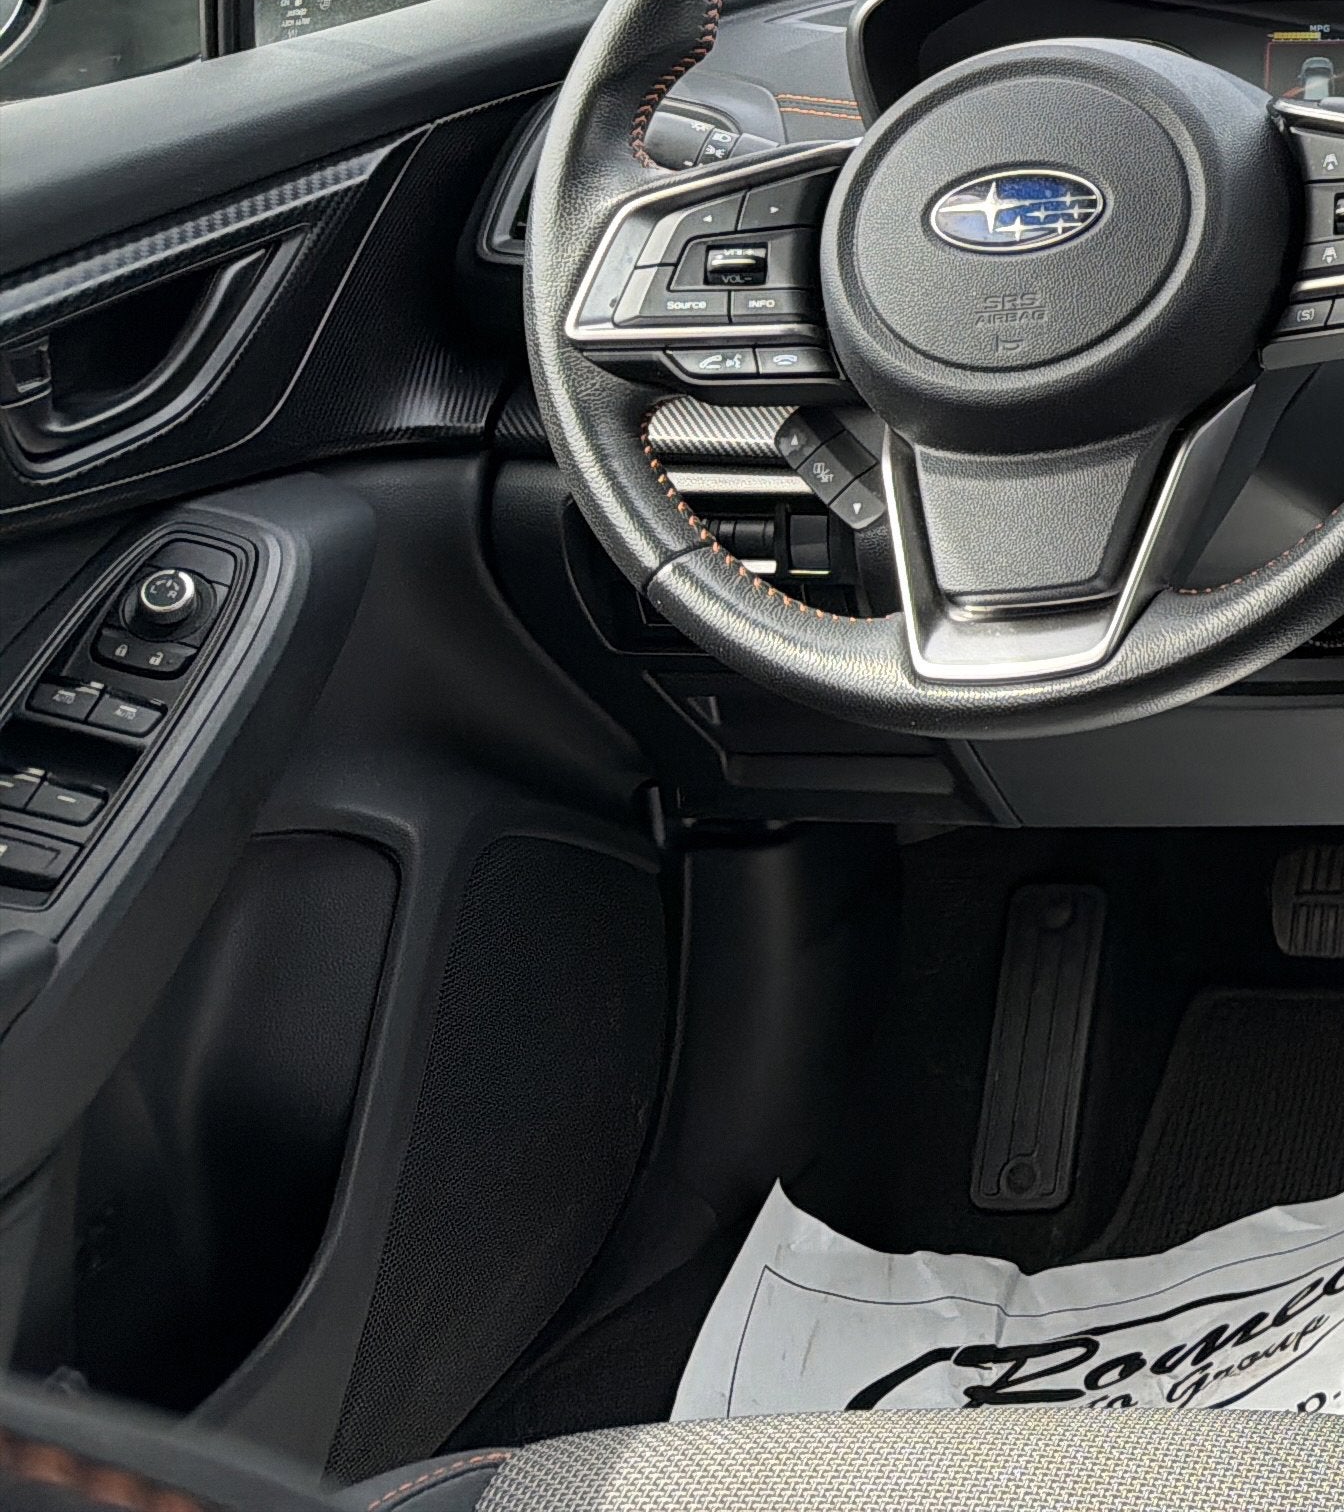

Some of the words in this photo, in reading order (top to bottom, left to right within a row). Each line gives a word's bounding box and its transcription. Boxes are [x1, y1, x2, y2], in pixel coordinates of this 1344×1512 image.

[1309, 24, 1331, 33] MPG
[666, 299, 707, 310] Source
[748, 299, 776, 309] INFO
[983, 292, 1037, 310] SRS
[973, 309, 1047, 326] AIRBAG
